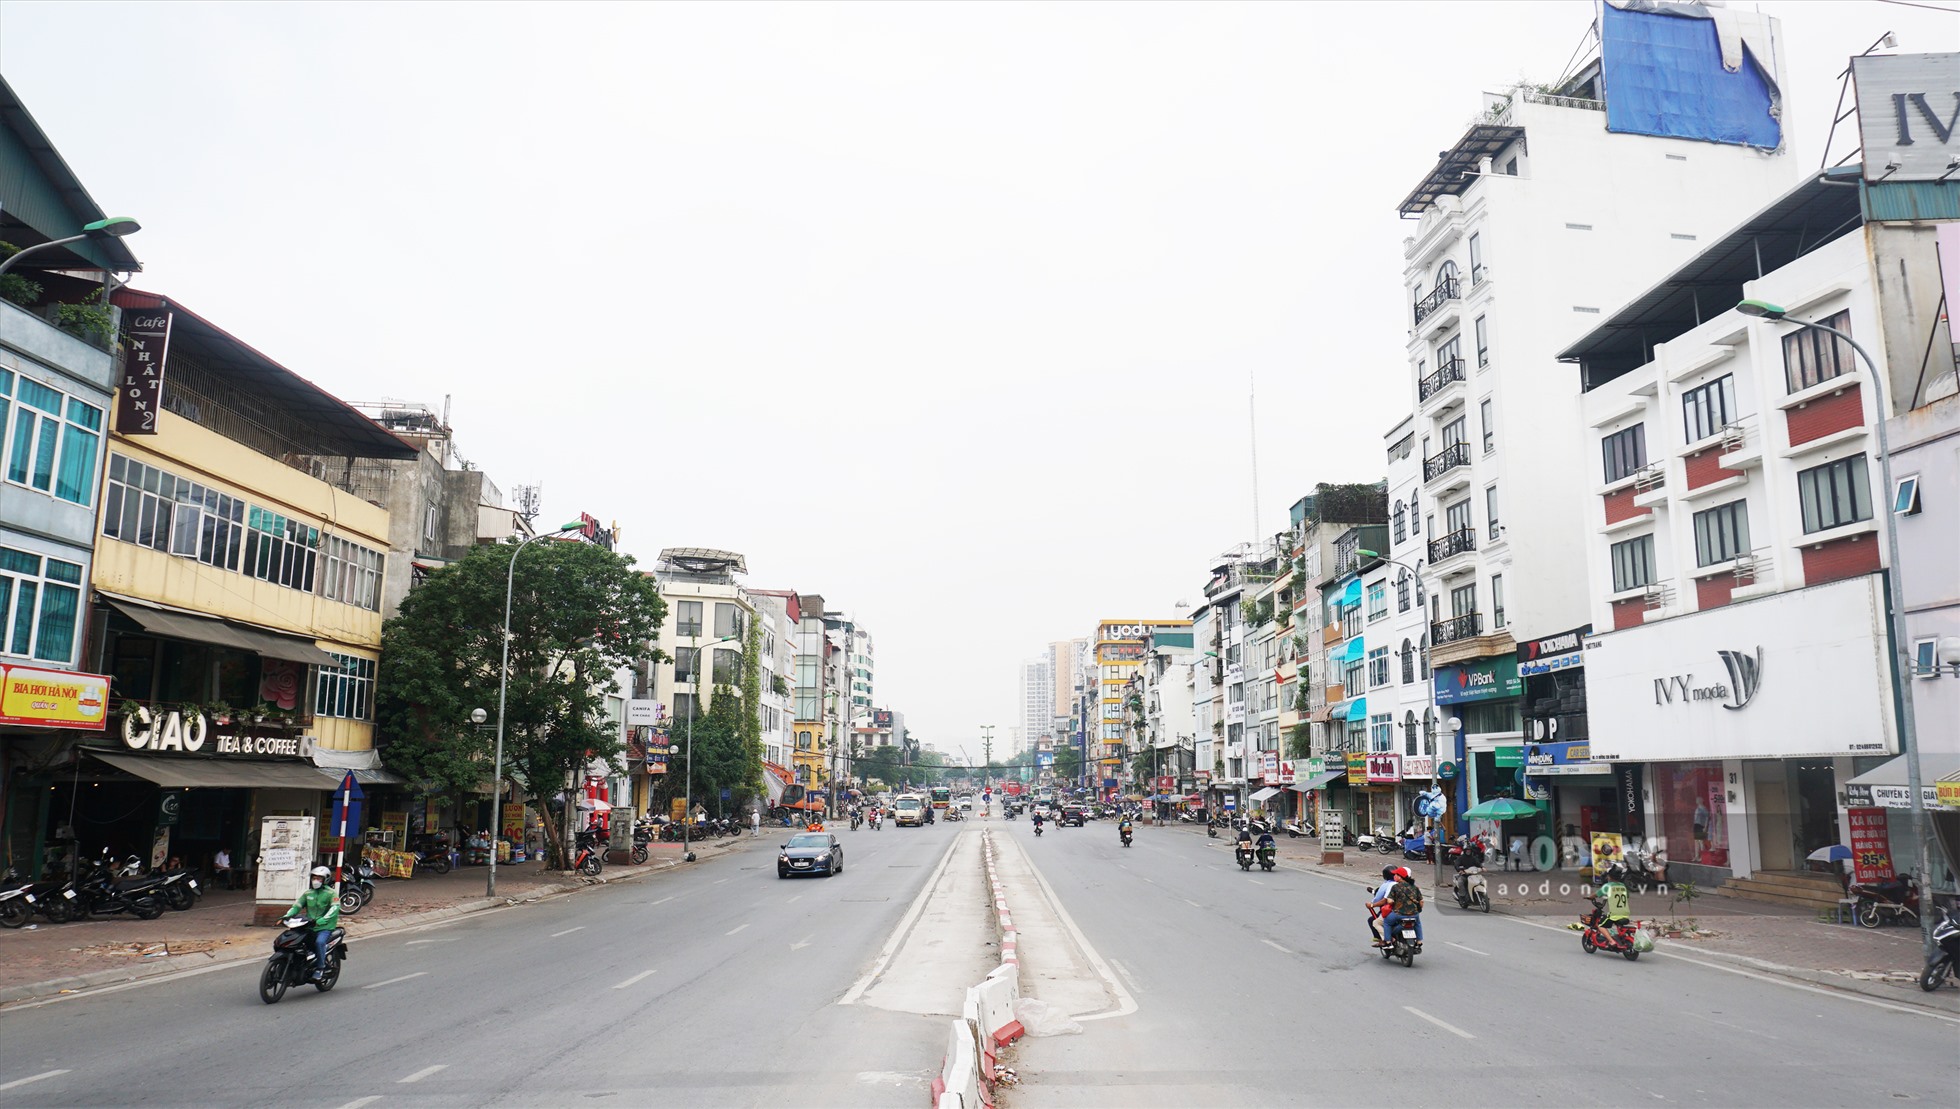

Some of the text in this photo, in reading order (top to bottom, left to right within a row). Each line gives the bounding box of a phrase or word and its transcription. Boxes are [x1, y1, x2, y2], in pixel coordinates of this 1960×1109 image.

[134, 316, 166, 328] Cafe
[1539, 633, 1578, 655] YOKOHAMA
[1468, 669, 1496, 687] VPBank
[13, 683, 28, 694] BIA
[48, 685, 60, 697] HÀ
[61, 686, 78, 701] NỘI
[1654, 673, 1727, 705] IVY moda
[123, 705, 298, 755] CIAO TEA & COFFEE
[1729, 772, 1737, 784] 31
[1625, 769, 1636, 813] YOKOHAMA
[1938, 785, 1952, 797] BÚN
[1614, 893, 1627, 908] 29
